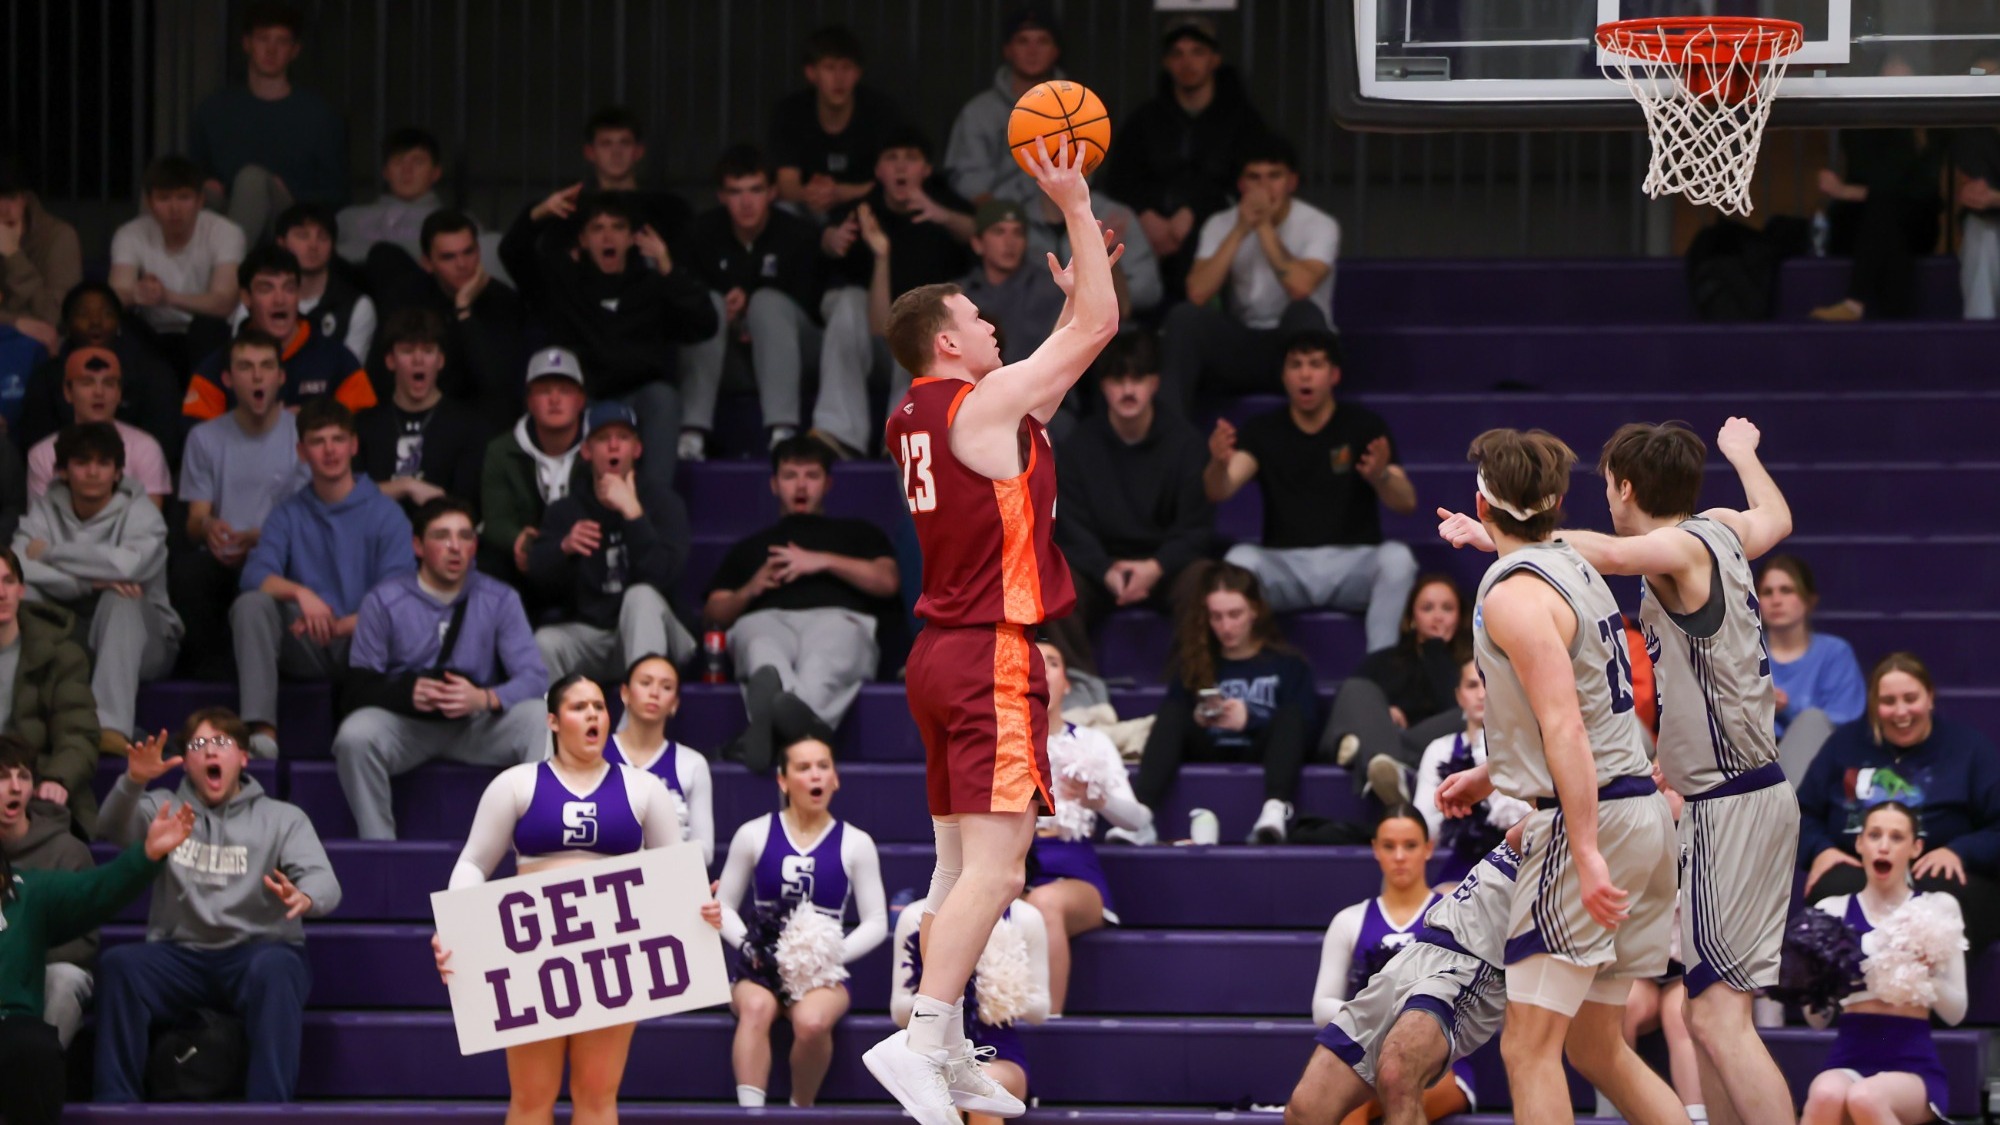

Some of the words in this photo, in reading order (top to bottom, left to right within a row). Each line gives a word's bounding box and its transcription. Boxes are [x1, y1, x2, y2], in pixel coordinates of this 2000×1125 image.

[562, 801, 599, 847] S
[498, 867, 645, 954] GET
[781, 854, 816, 901] S
[484, 935, 691, 1032] LOUD
